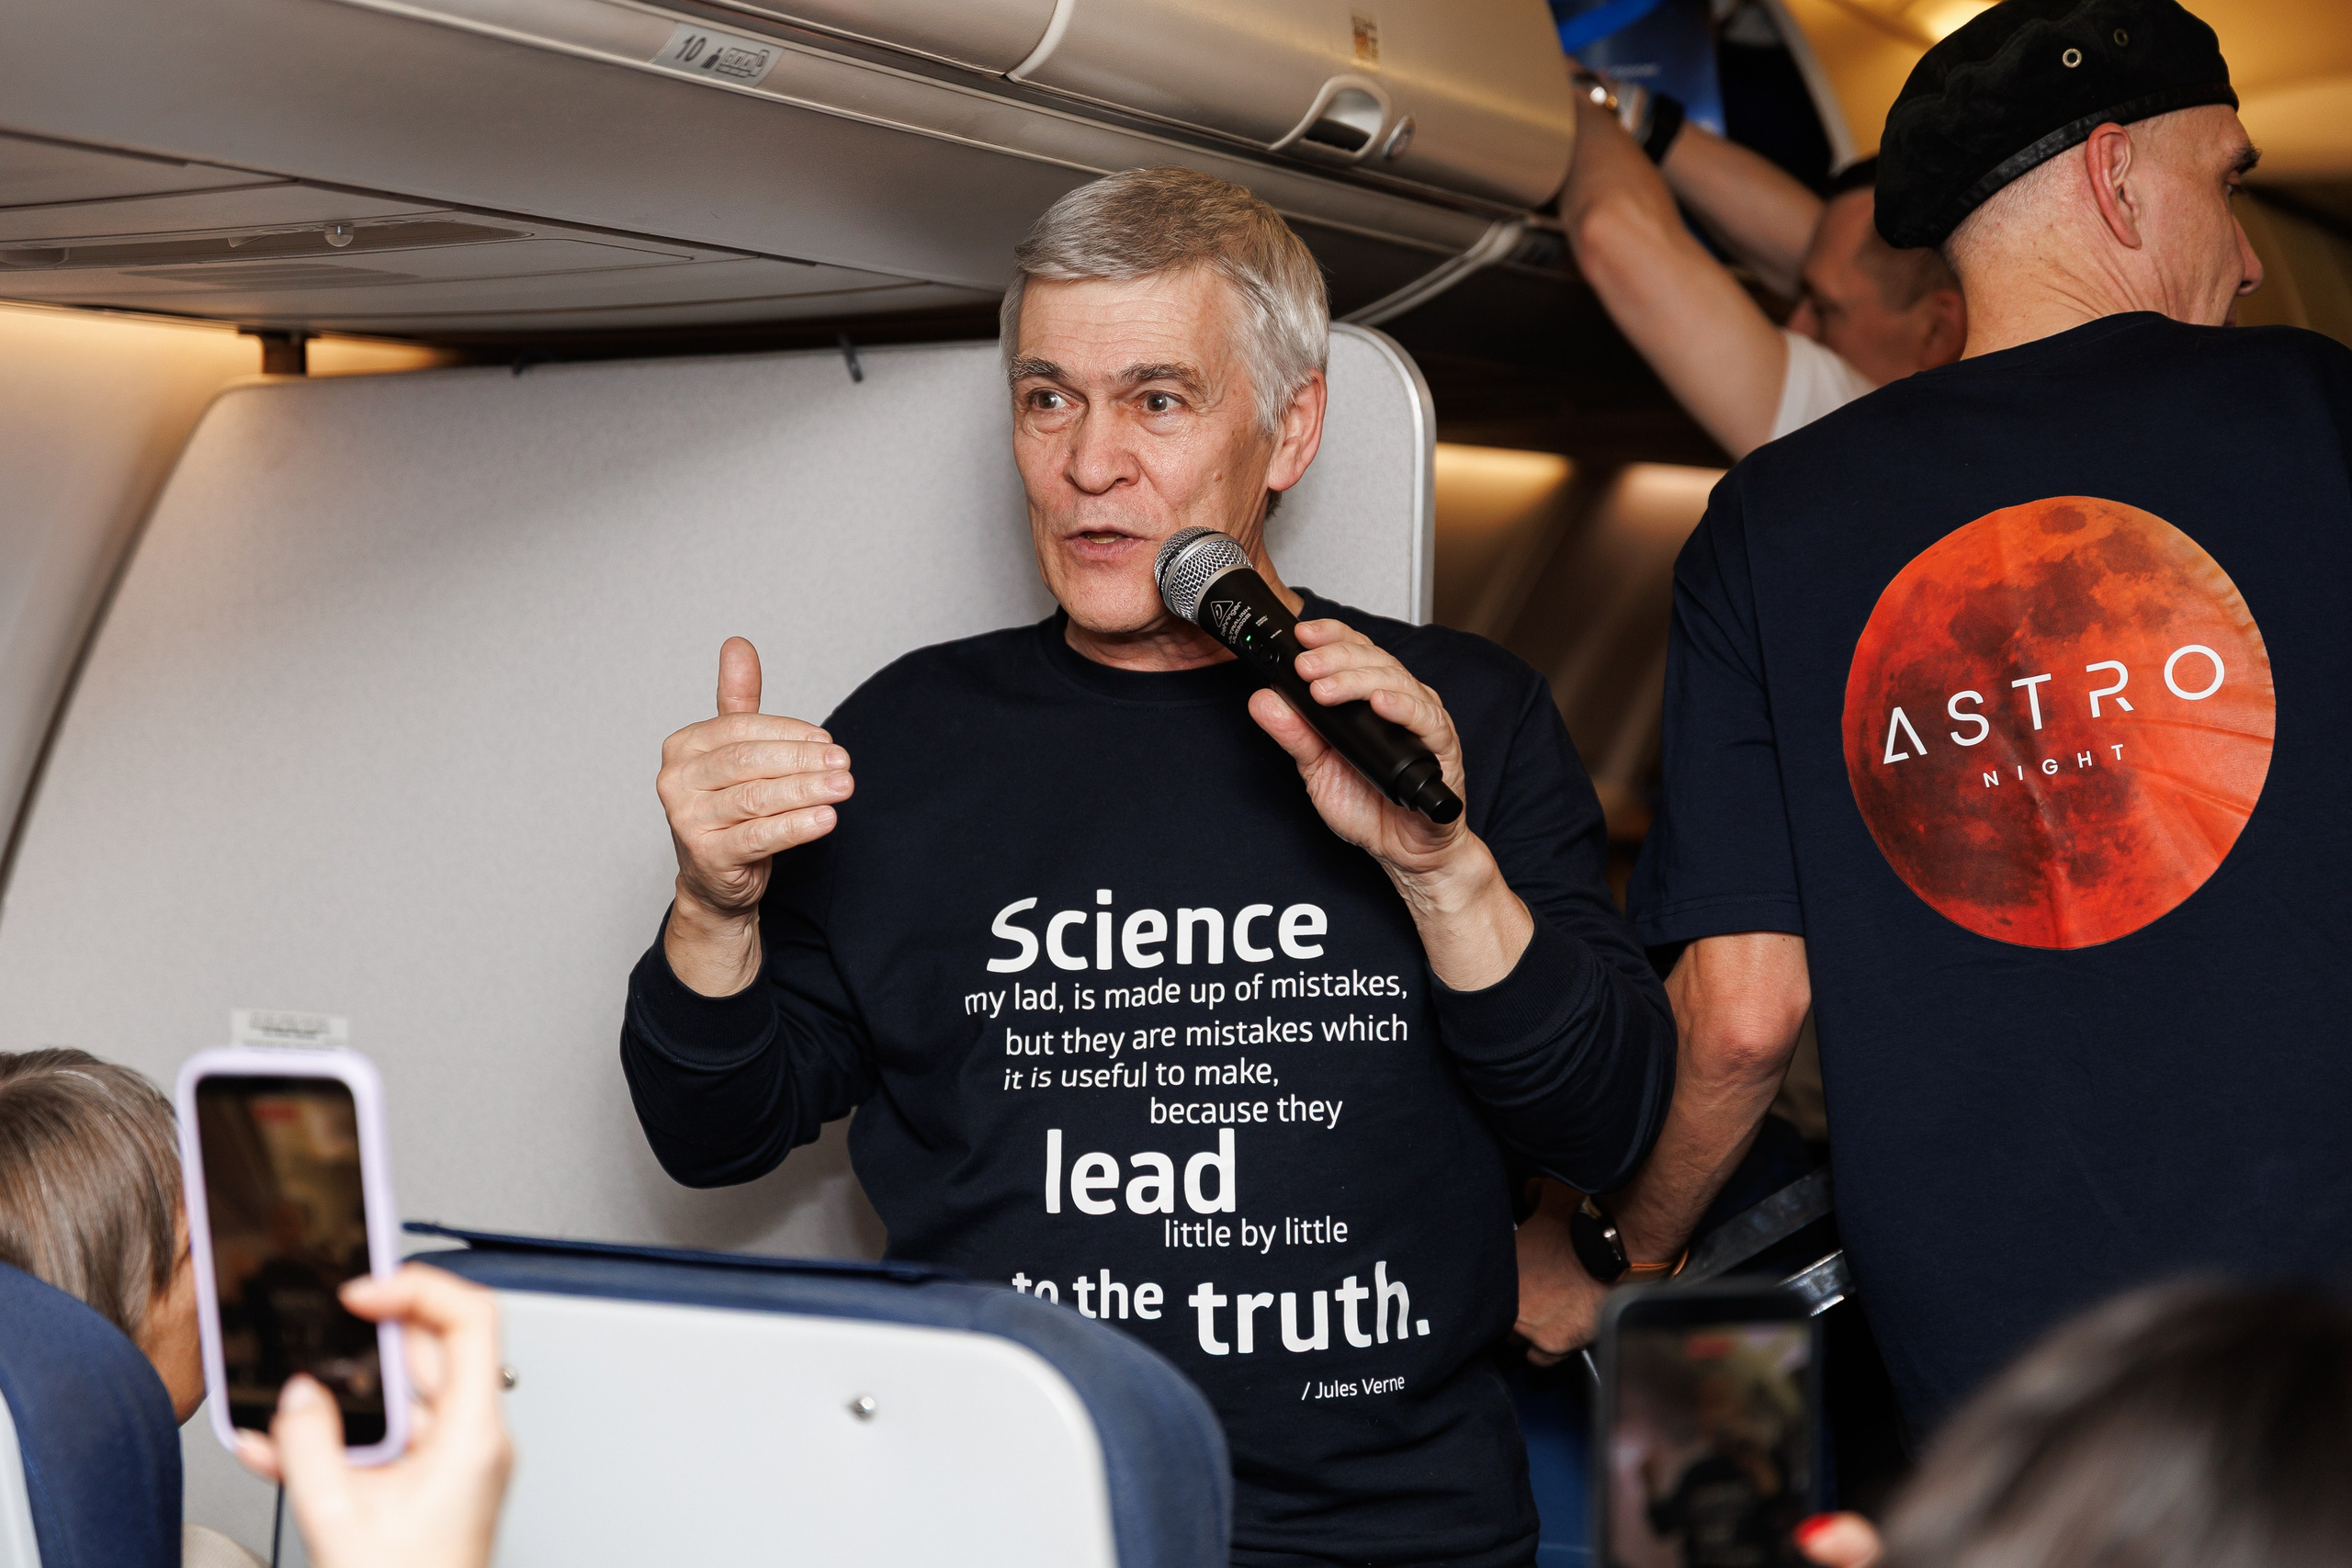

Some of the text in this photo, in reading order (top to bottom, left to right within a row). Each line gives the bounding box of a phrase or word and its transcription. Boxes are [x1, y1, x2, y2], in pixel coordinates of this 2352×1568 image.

[675, 35, 708, 62] 10
[1883, 644, 2225, 764] ASTRO
[1983, 743, 2125, 788] NIGHT
[986, 888, 1329, 974] Science
[964, 968, 1408, 1019] my lad, is made up of mistakes,
[1006, 1012, 1408, 1059] but they are mistakes which
[1003, 1056, 1279, 1091] it is useful to make,
[1150, 1093, 1343, 1130] because they
[1045, 1127, 1237, 1215] lead
[1165, 1214, 1349, 1255] little by little
[1072, 1268, 1164, 1320] the
[1188, 1260, 1430, 1356] truth.
[1314, 1380, 1358, 1400] Jules
[1361, 1376, 1406, 1395] Verne
